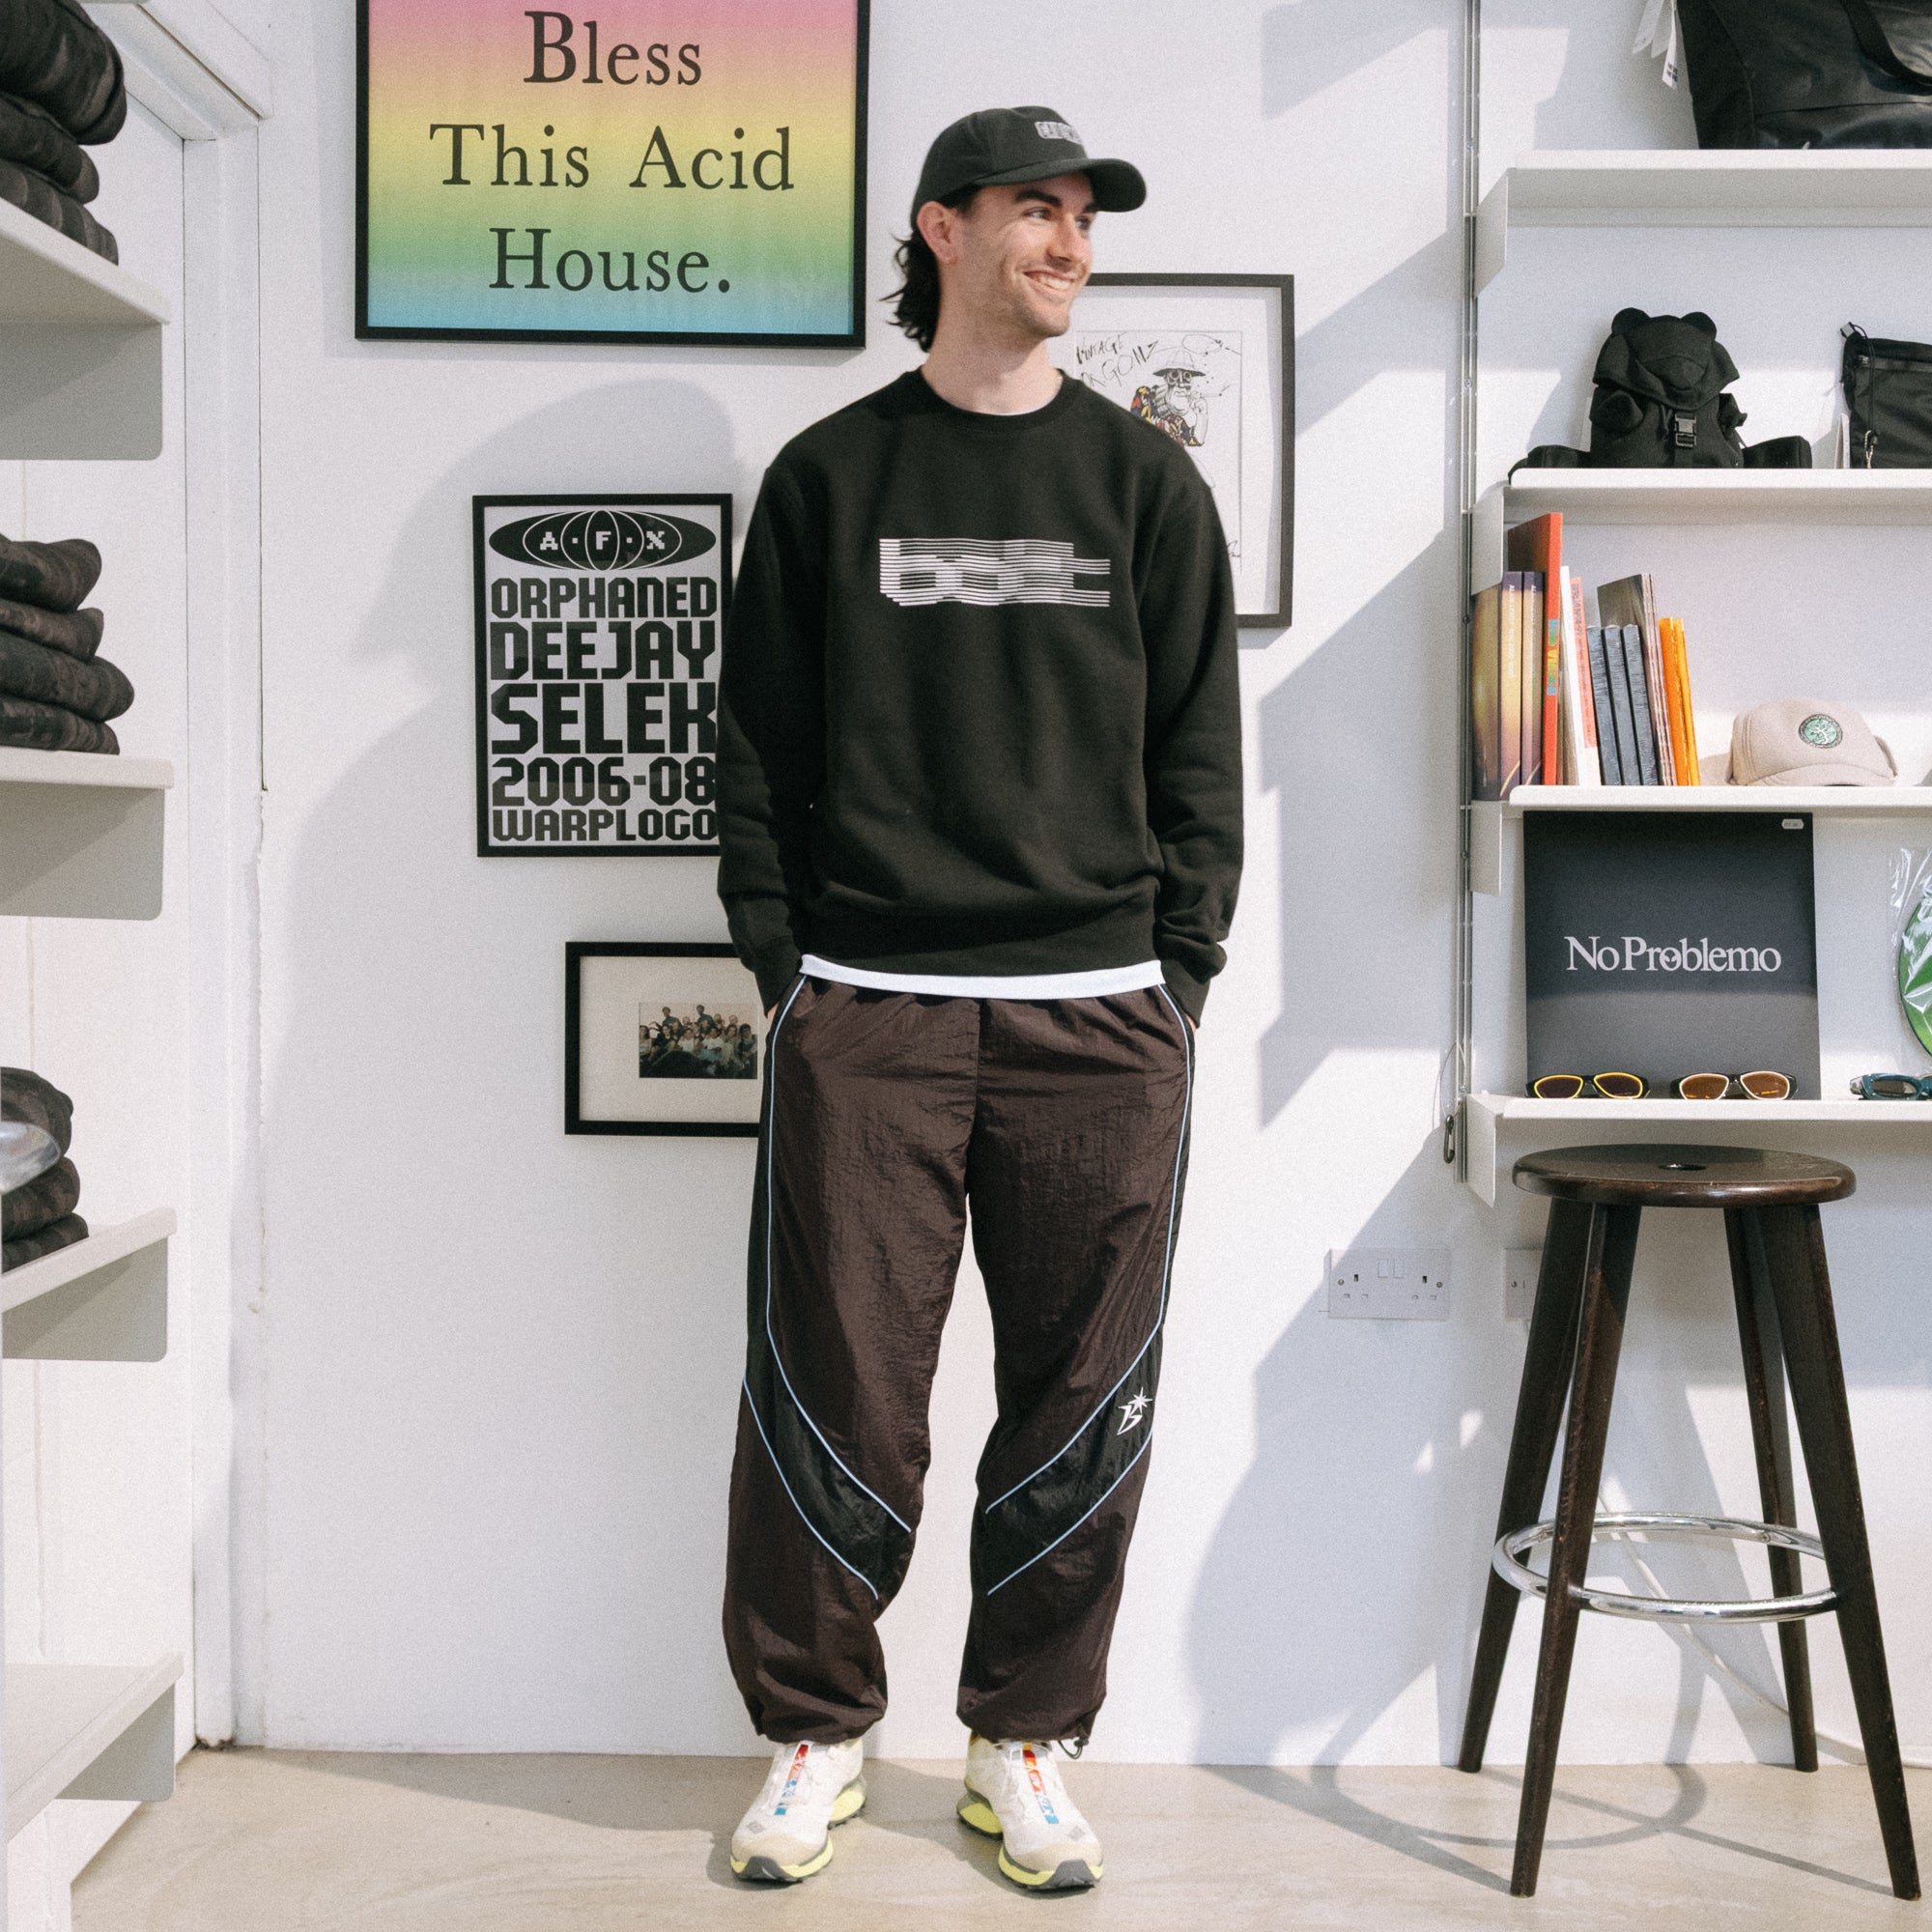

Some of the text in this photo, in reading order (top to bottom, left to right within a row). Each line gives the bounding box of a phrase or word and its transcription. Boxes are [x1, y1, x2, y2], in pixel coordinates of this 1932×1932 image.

[523, 11, 701, 86] Bless
[429, 124, 794, 191] This Acid
[489, 227, 730, 294] House.
[491, 577, 718, 619] ORPHANED
[490, 620, 716, 680] DEEJAY
[491, 682, 716, 754] SELEK
[492, 756, 716, 807] 2006-08
[493, 808, 718, 841] WARPLOGO
[1564, 936, 1781, 973] No Problemo
